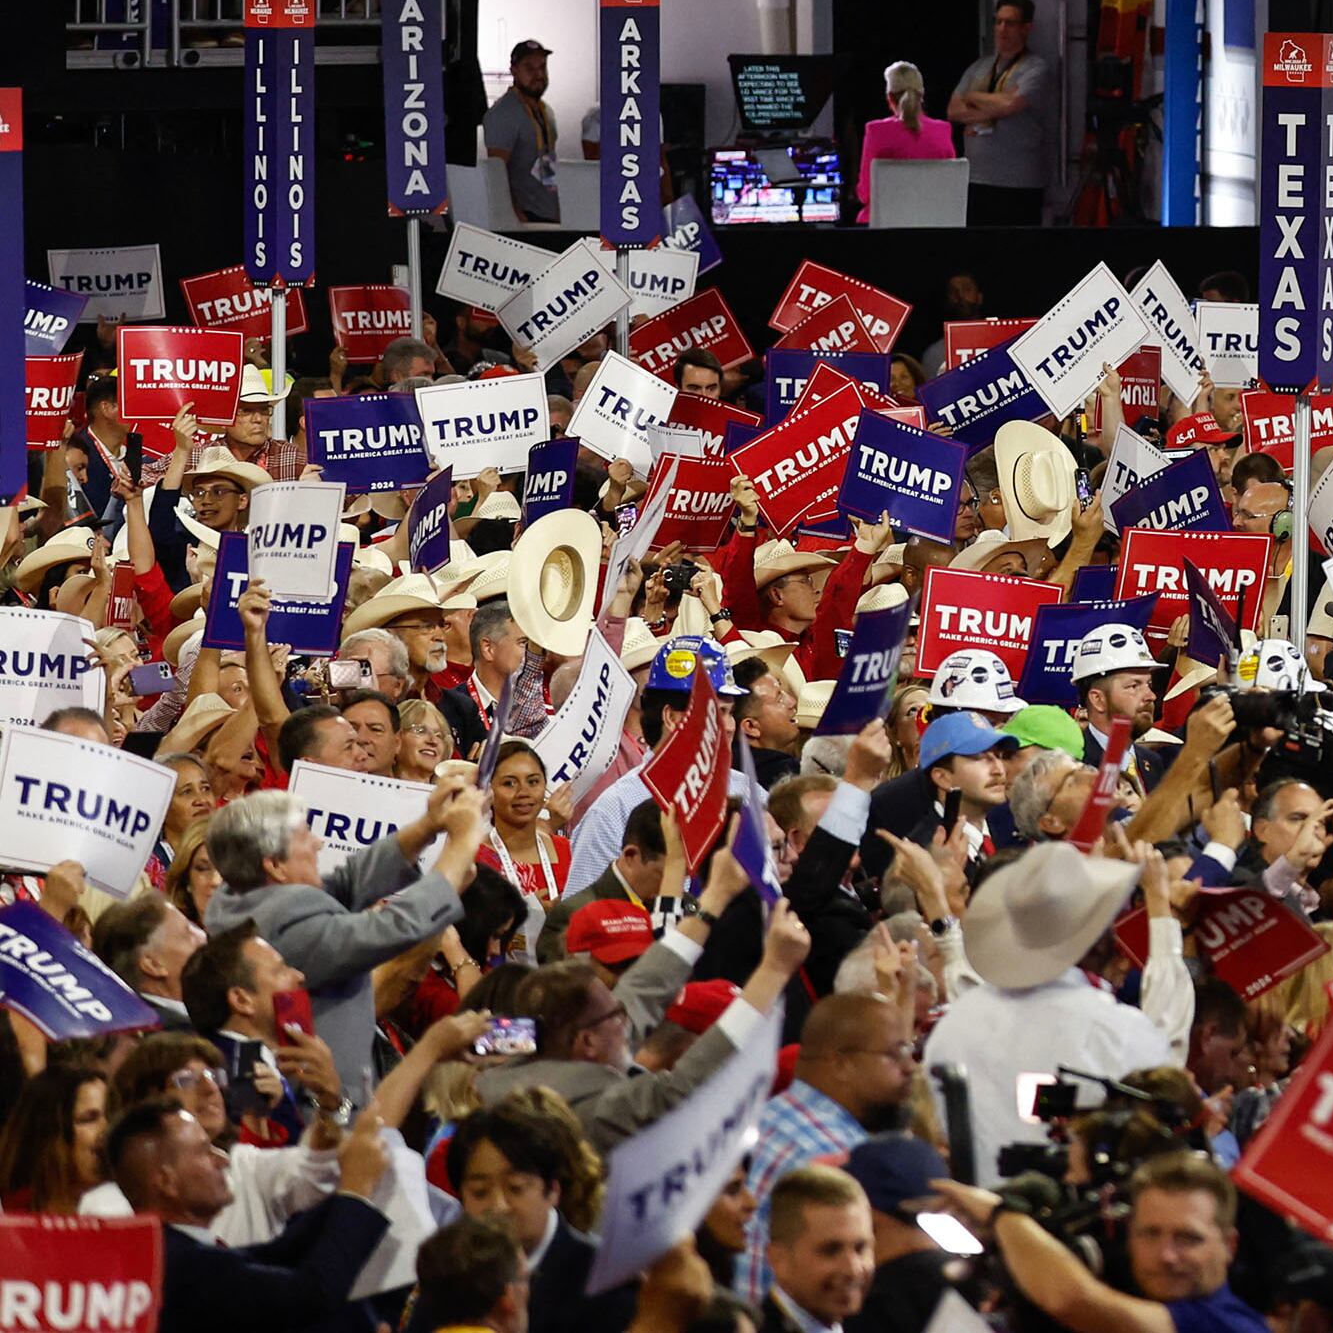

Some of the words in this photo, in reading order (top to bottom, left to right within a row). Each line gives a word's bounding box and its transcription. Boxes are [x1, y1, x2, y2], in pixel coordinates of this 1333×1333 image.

[1273, 63, 1313, 72] MILWAUKEE
[254, 39, 268, 268] ILLINOIS
[289, 39, 304, 268] ILLINOIS
[619, 18, 642, 230] ARKANSAS
[1272, 113, 1306, 363] TEXAS
[60, 271, 151, 293] TRUMP
[517, 270, 600, 342] TRUMP
[640, 315, 727, 369] TRUMP
[1035, 296, 1120, 380] TRUMP
[1142, 288, 1203, 371] TRUMP
[130, 358, 235, 383] TRUMP
[320, 424, 420, 451] TRUMP
[432, 408, 538, 439] TRUMP
[754, 415, 860, 493] TRUMP
[371, 481, 394, 490] 2024
[816, 485, 839, 502] 2024
[859, 445, 952, 495] TRUMP
[552, 663, 610, 784] TRUMP
[674, 700, 718, 809] TRUMP
[14, 776, 150, 838] TRUMP
